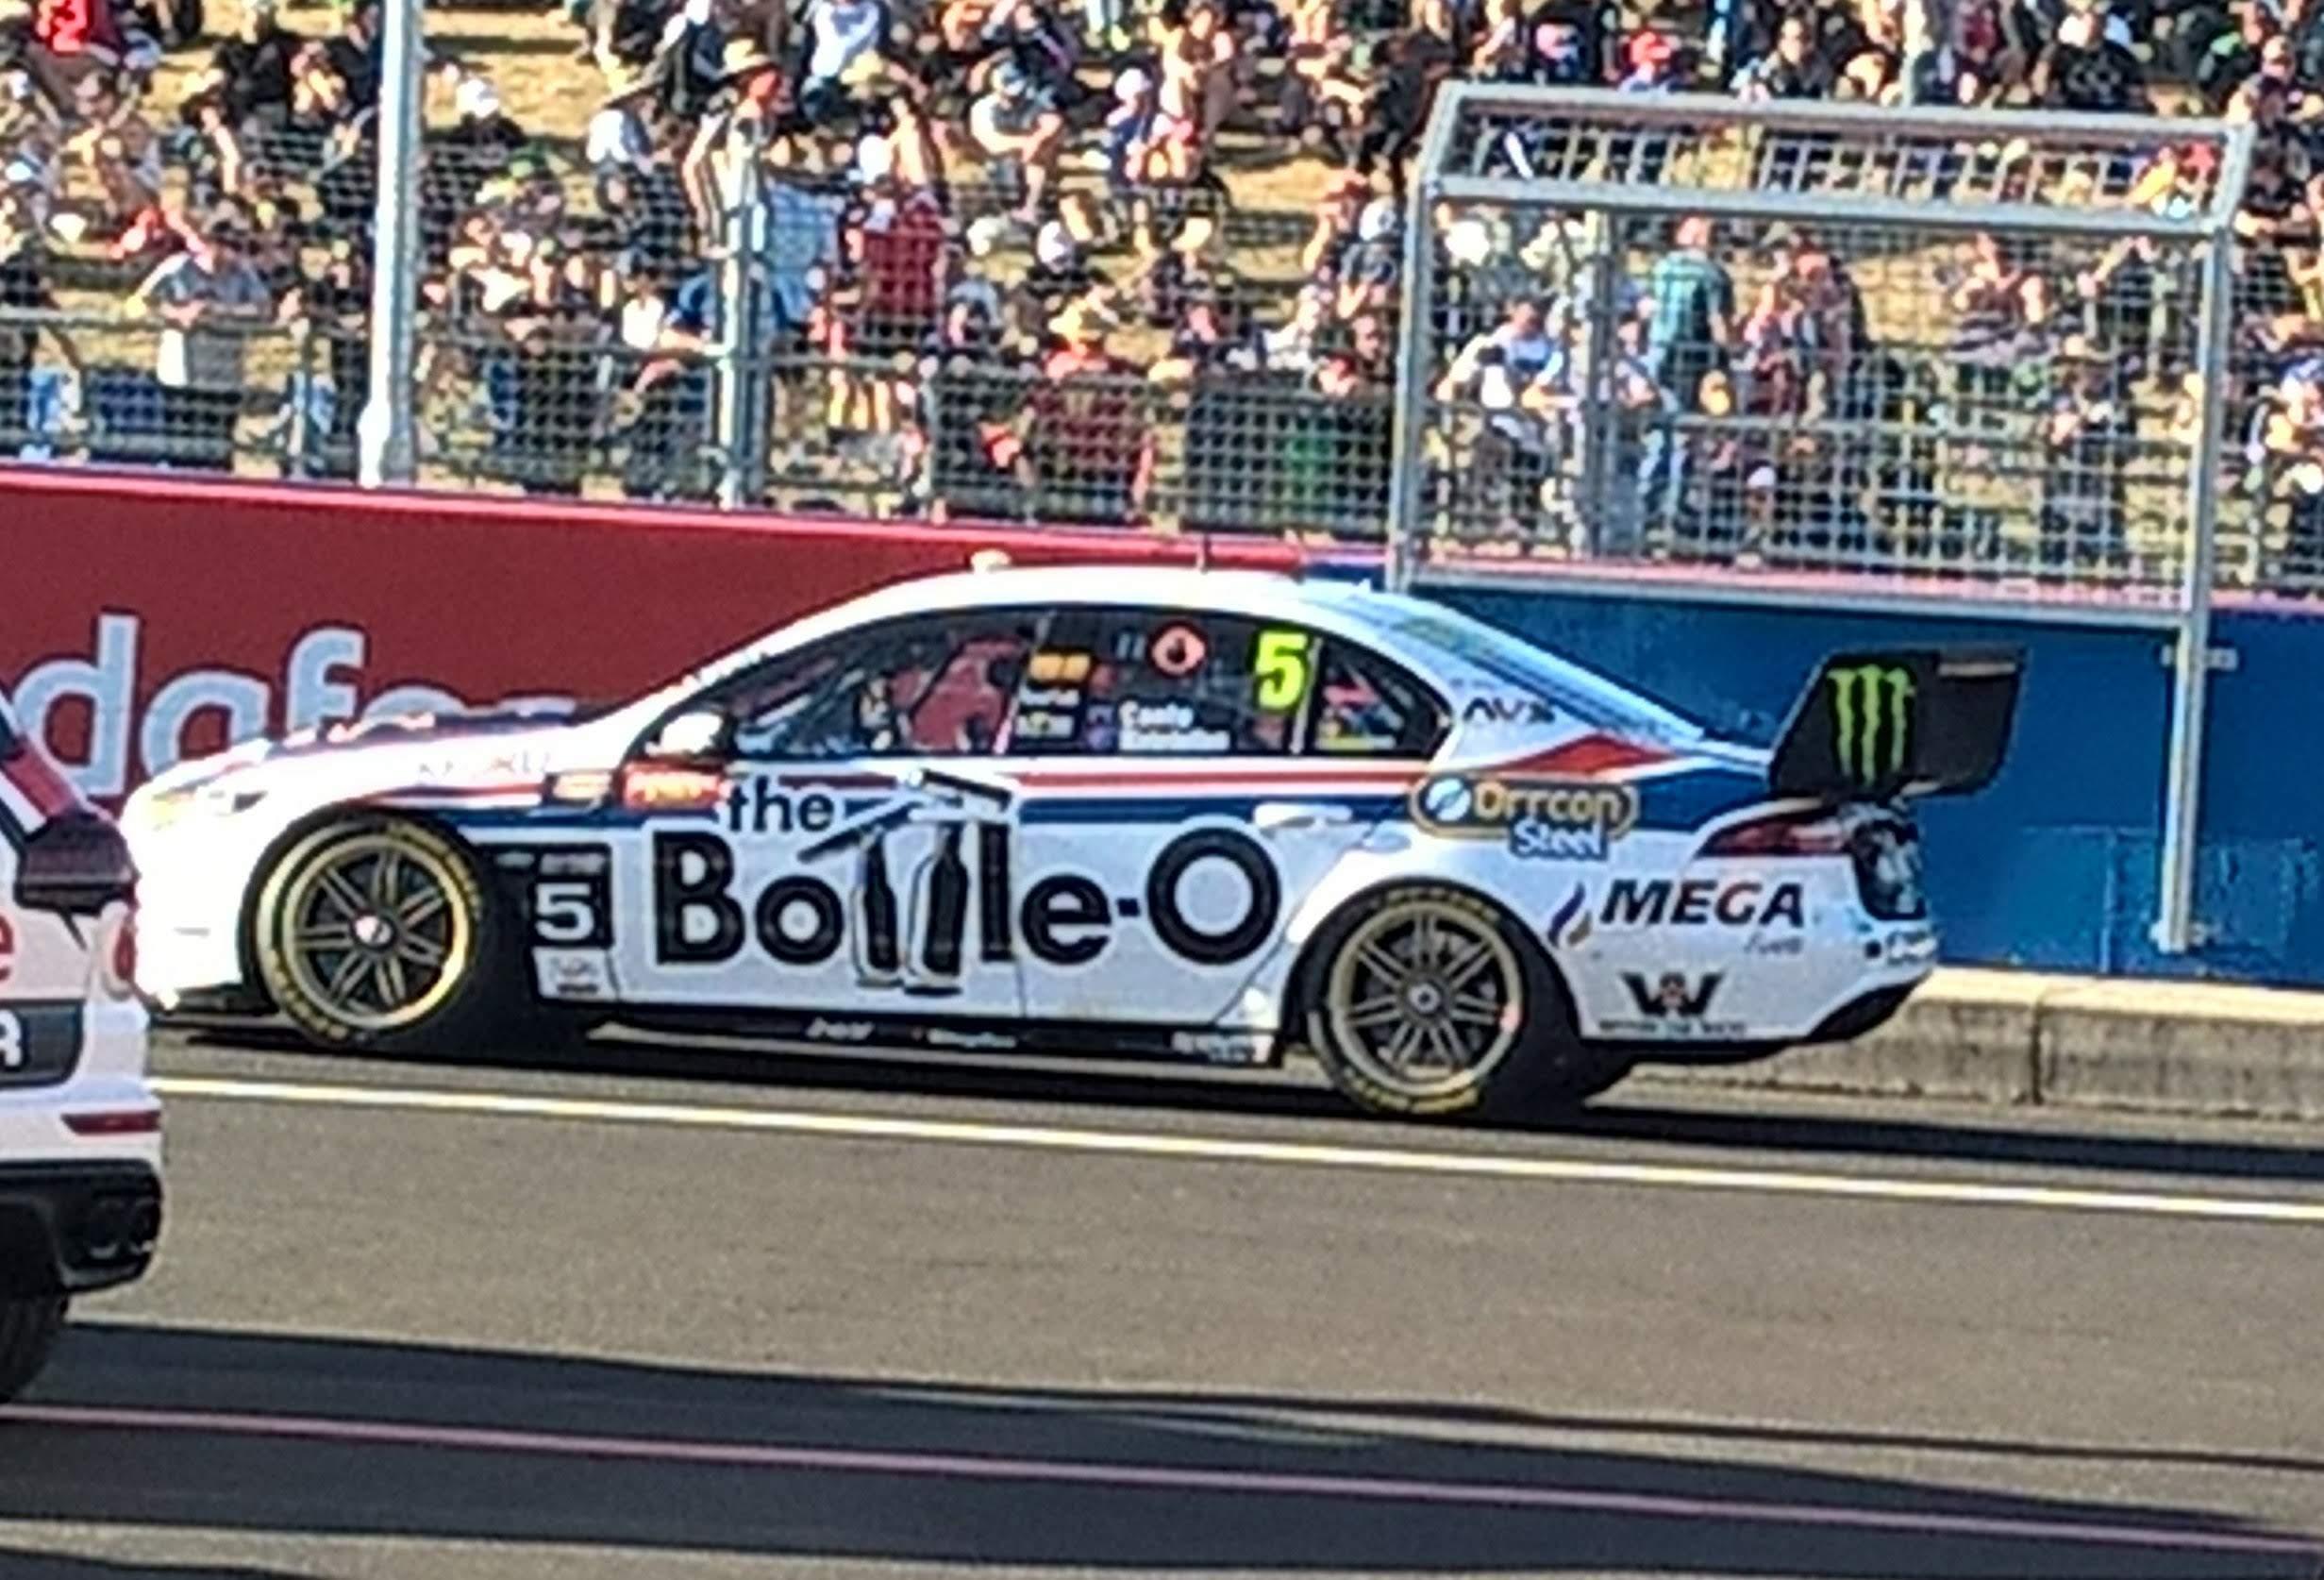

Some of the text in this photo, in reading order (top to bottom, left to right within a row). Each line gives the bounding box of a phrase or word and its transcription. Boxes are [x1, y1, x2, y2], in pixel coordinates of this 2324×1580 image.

[1255, 630, 1307, 709] 5
[727, 776, 834, 832] the
[535, 882, 594, 941] 5
[1600, 879, 1804, 929] MEGA
